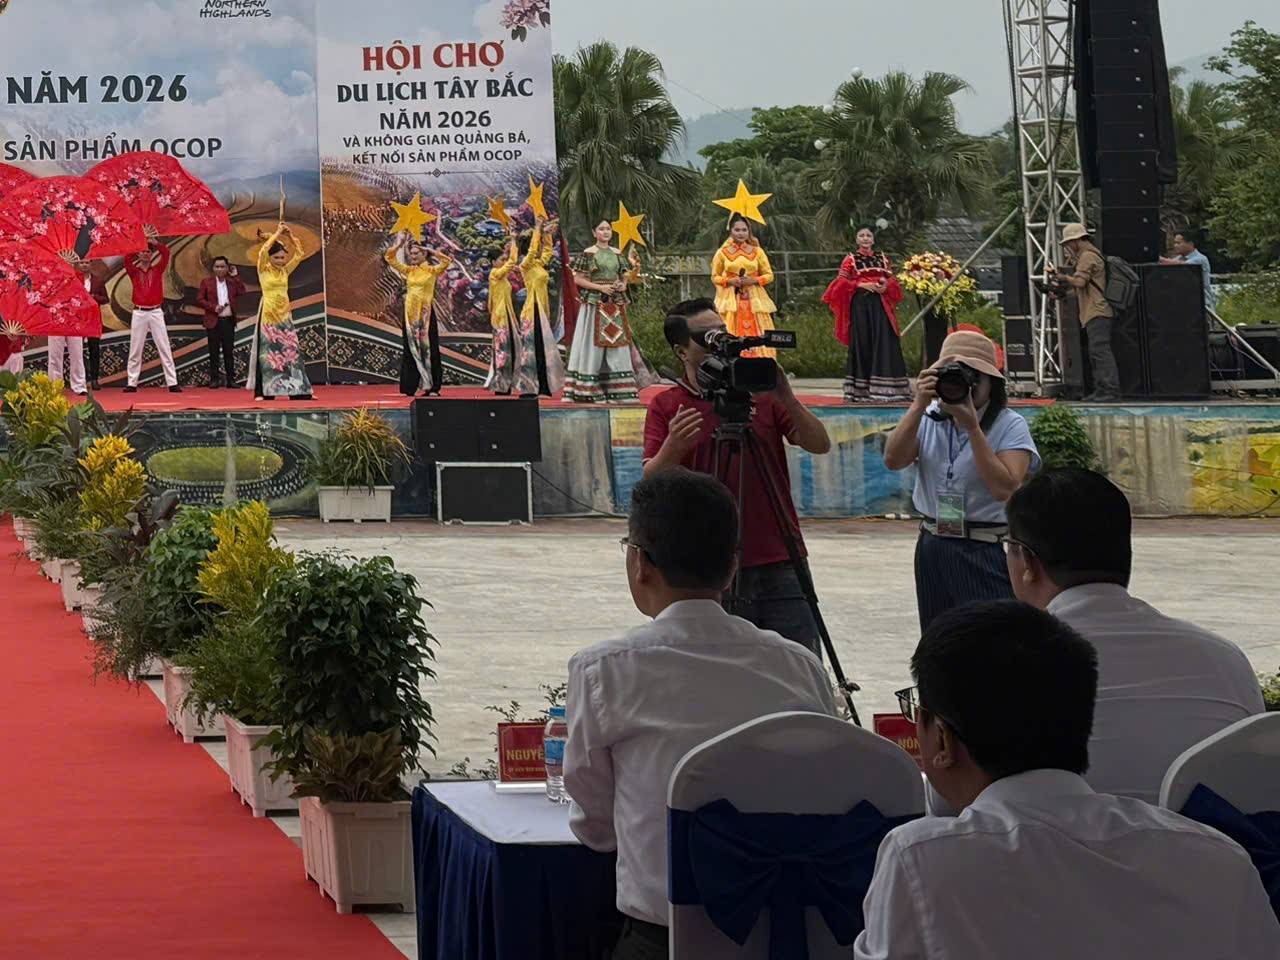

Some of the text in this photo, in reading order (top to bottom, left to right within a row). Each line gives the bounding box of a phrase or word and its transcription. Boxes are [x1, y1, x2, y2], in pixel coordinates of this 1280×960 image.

[200, 8, 272, 18] HIGHLANDS
[362, 40, 505, 76] HỘI CHỢ
[7, 70, 88, 104] NĂM
[101, 74, 188, 103] 2026
[337, 72, 534, 105] DU LỊCH TÂY BẮC
[379, 108, 492, 130] NĂM 2026
[5, 134, 56, 160] SẢN
[65, 132, 141, 159] PHẨM
[150, 138, 223, 158] OCOP
[343, 134, 361, 148] VÀ
[364, 132, 413, 147] KHÔNG
[416, 134, 451, 146] GIAN
[508, 130, 531, 145] BÁ,
[352, 150, 378, 165] KẾT
[380, 149, 405, 164] NỐI
[439, 147, 480, 163] PHẨM
[484, 150, 522, 161] OCOP
